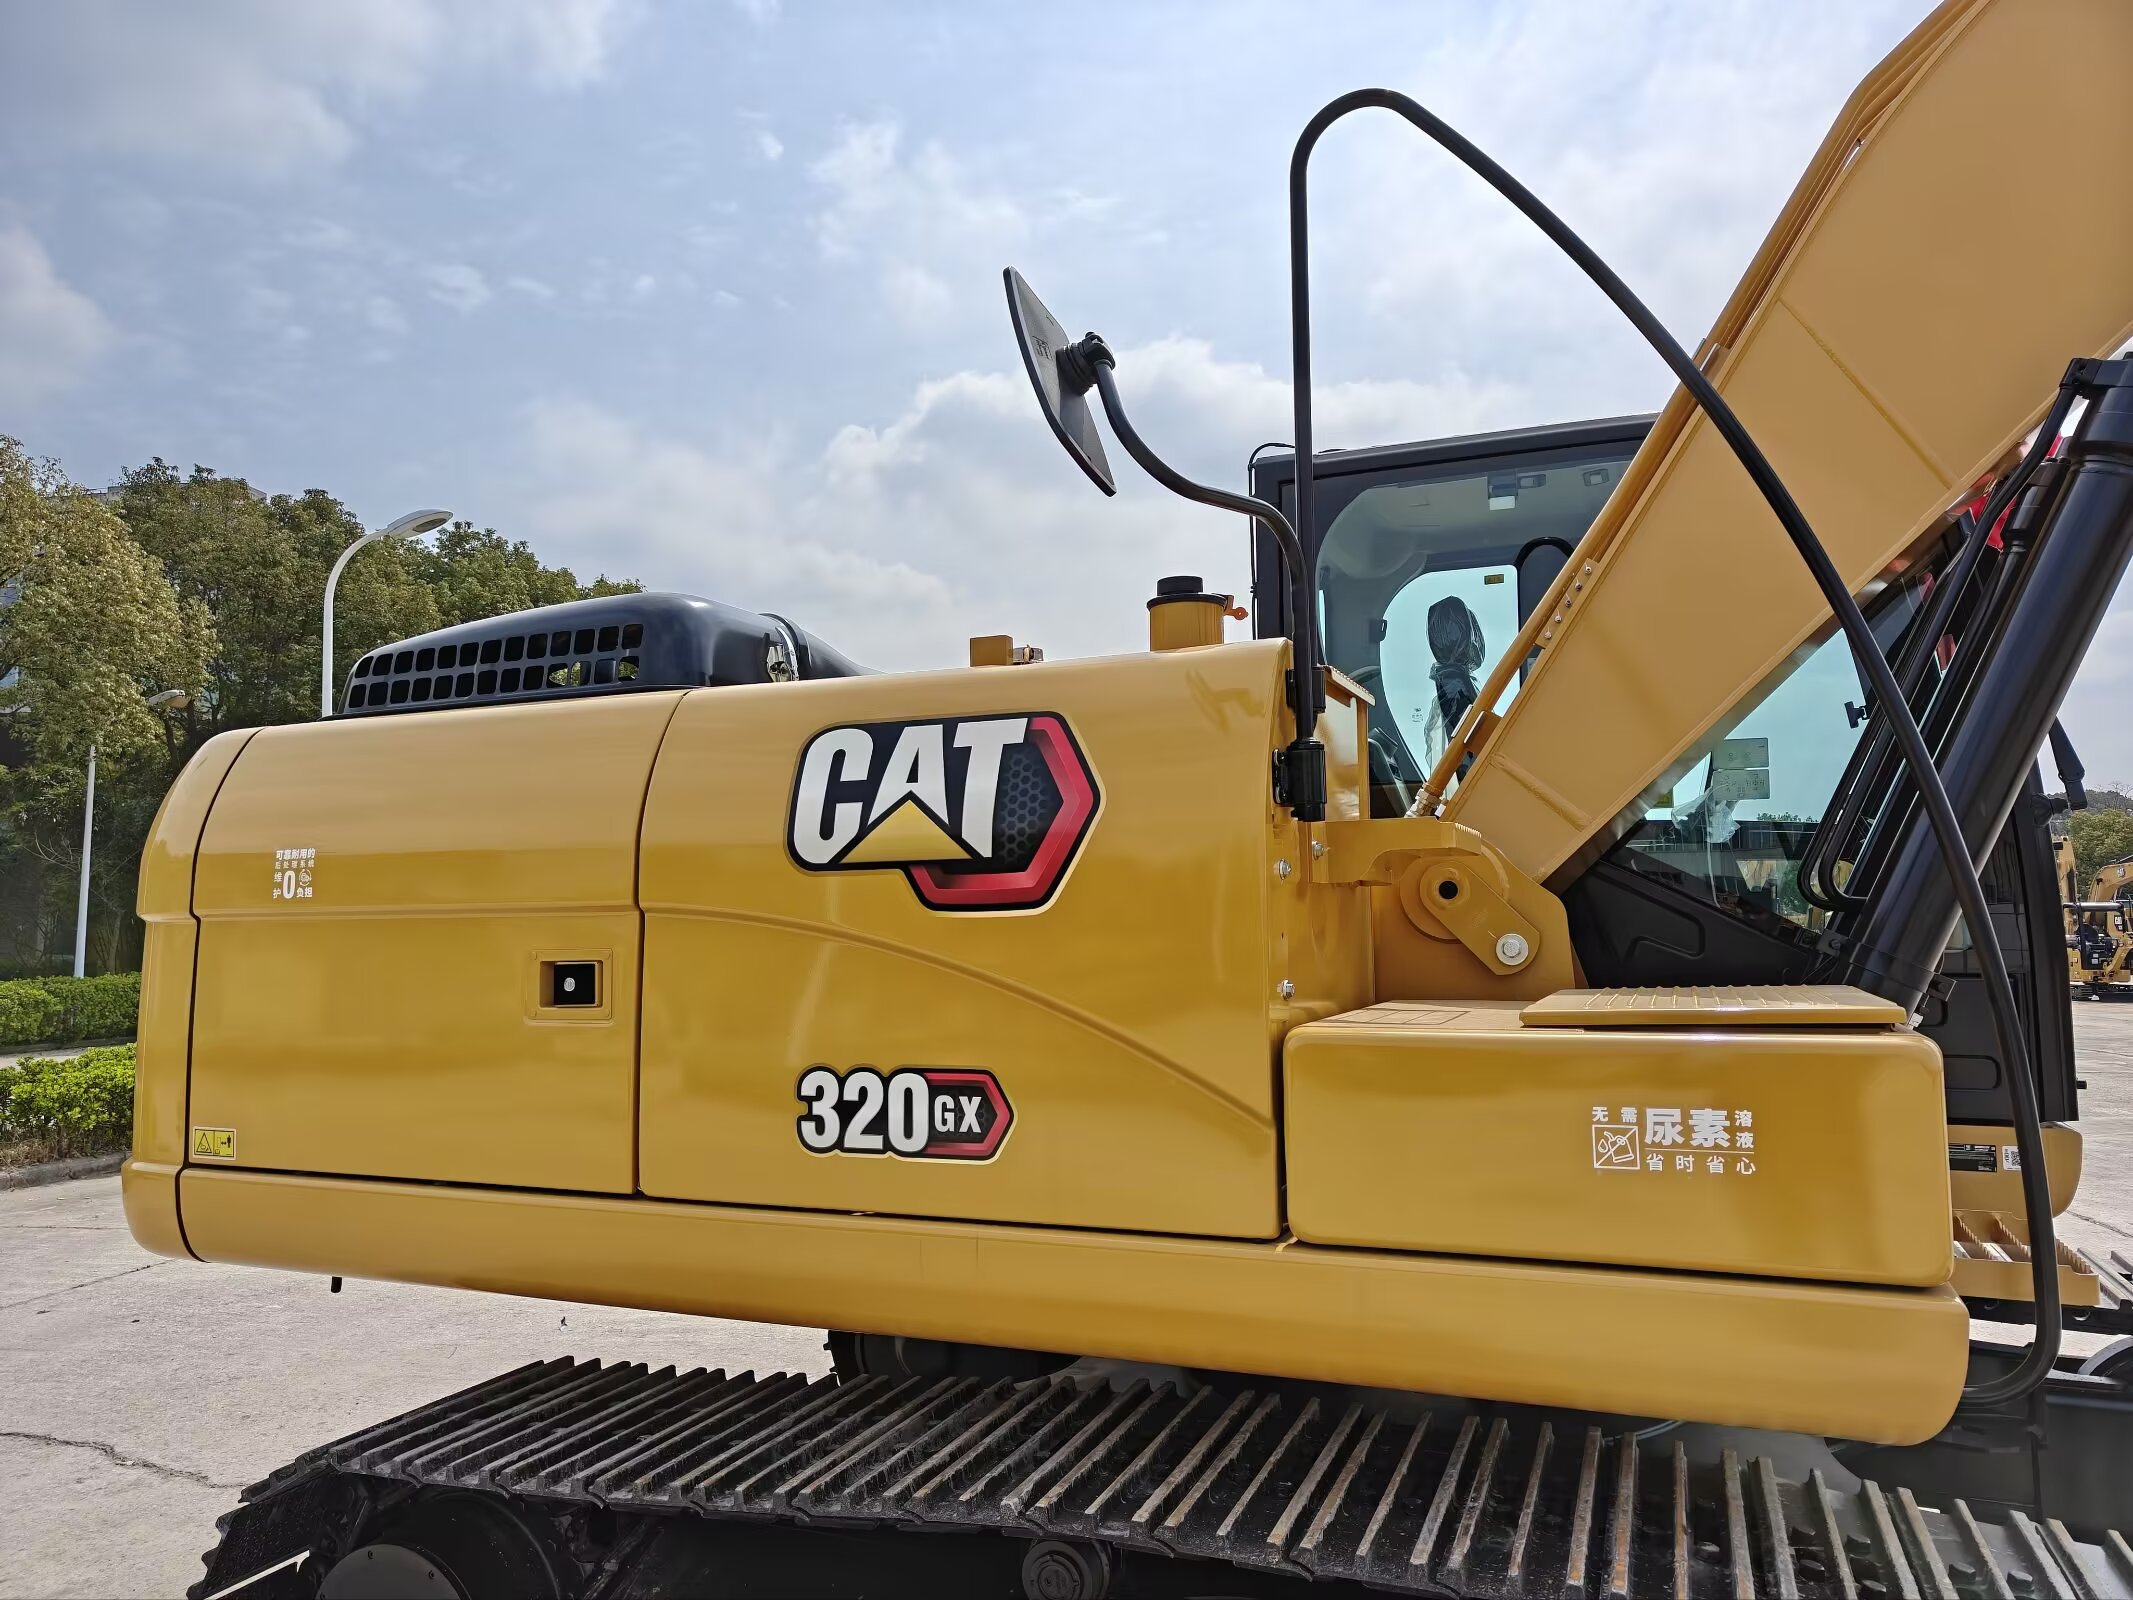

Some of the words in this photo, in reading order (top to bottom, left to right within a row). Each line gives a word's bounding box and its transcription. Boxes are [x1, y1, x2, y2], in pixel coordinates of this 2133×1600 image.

[794, 717, 1028, 864] CAT
[282, 870, 296, 899] 0
[296, 887, 313, 898] 负担
[800, 1070, 929, 1153] 320
[934, 1094, 982, 1133] GX
[1592, 1106, 1638, 1123] 无需
[1644, 1108, 1731, 1148] 尿素
[1734, 1109, 1755, 1148] 溶液
[1646, 1153, 1756, 1175] 省时省心
